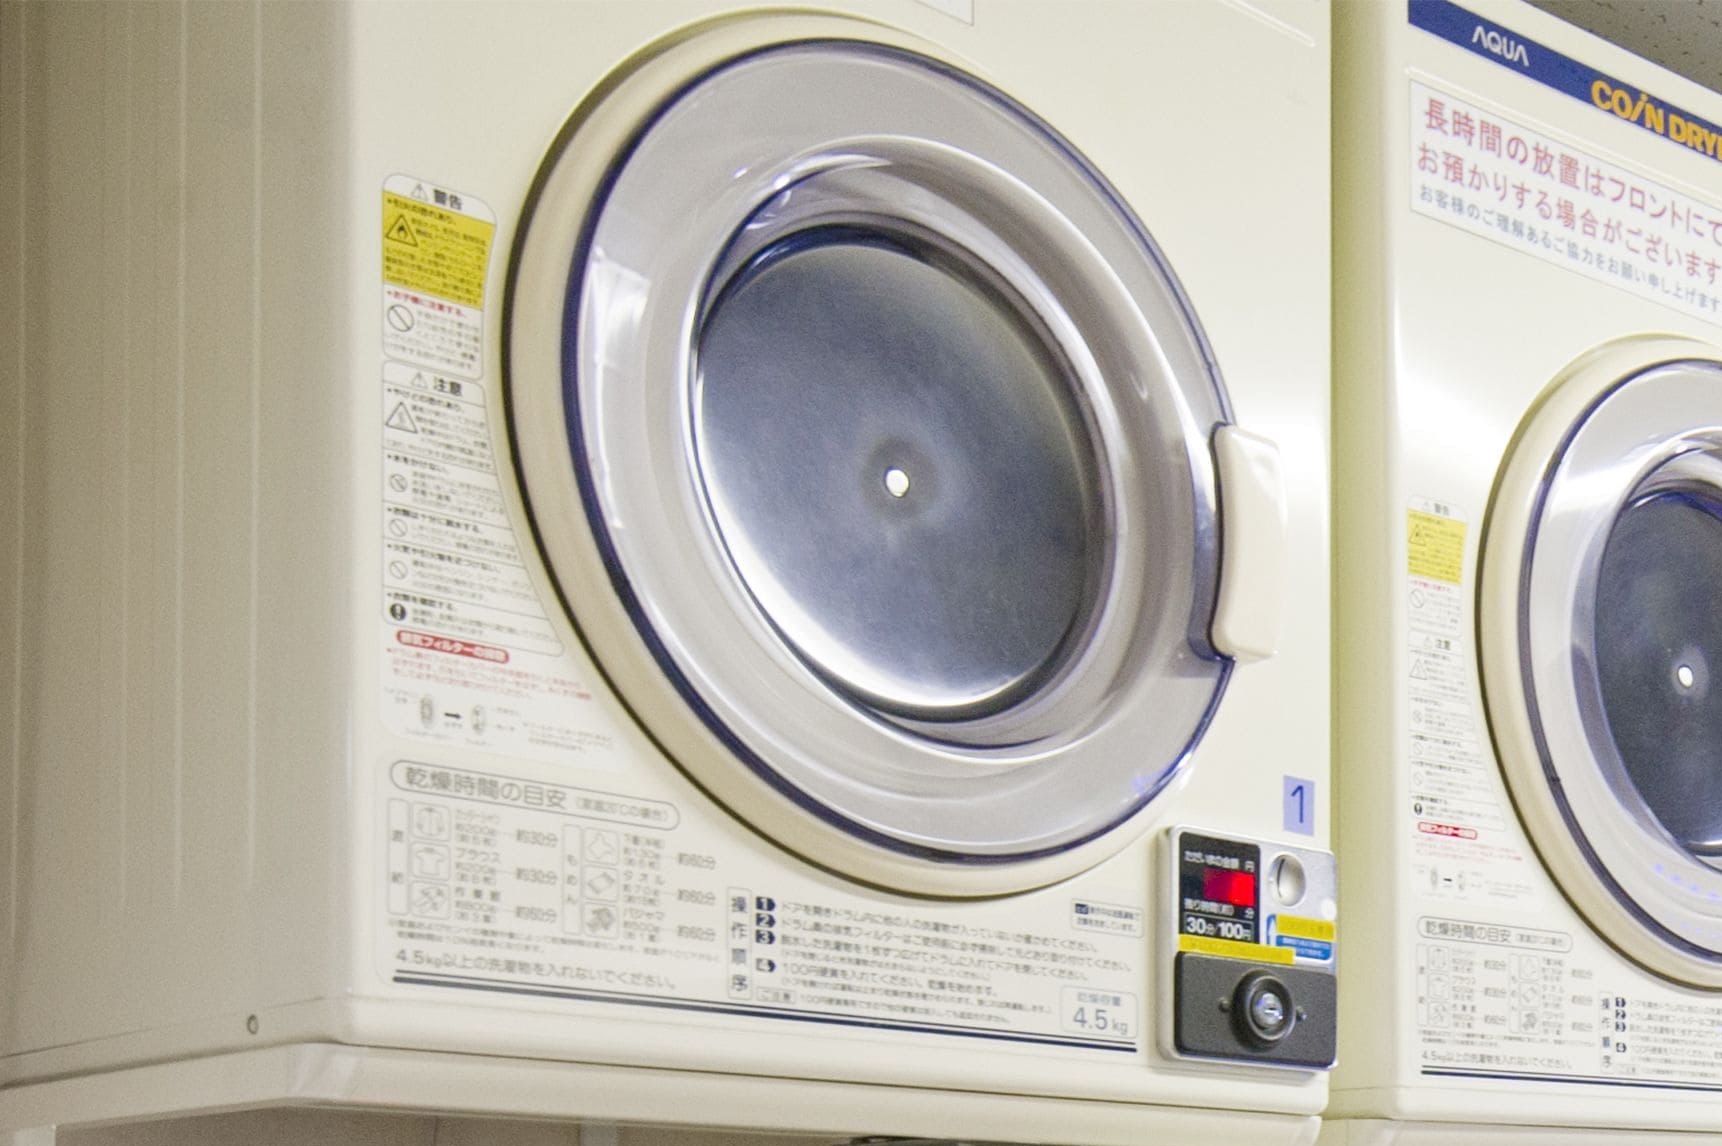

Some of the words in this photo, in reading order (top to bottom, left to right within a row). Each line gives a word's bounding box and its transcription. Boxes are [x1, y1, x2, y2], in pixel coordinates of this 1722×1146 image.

[1472, 25, 1530, 68] AQUA
[433, 189, 463, 211] 警告
[433, 378, 463, 397] 注意
[405, 766, 567, 810] 乾燥時間の目安
[1291, 785, 1305, 824] 1
[1424, 919, 1512, 944] 乾燥時間の目安
